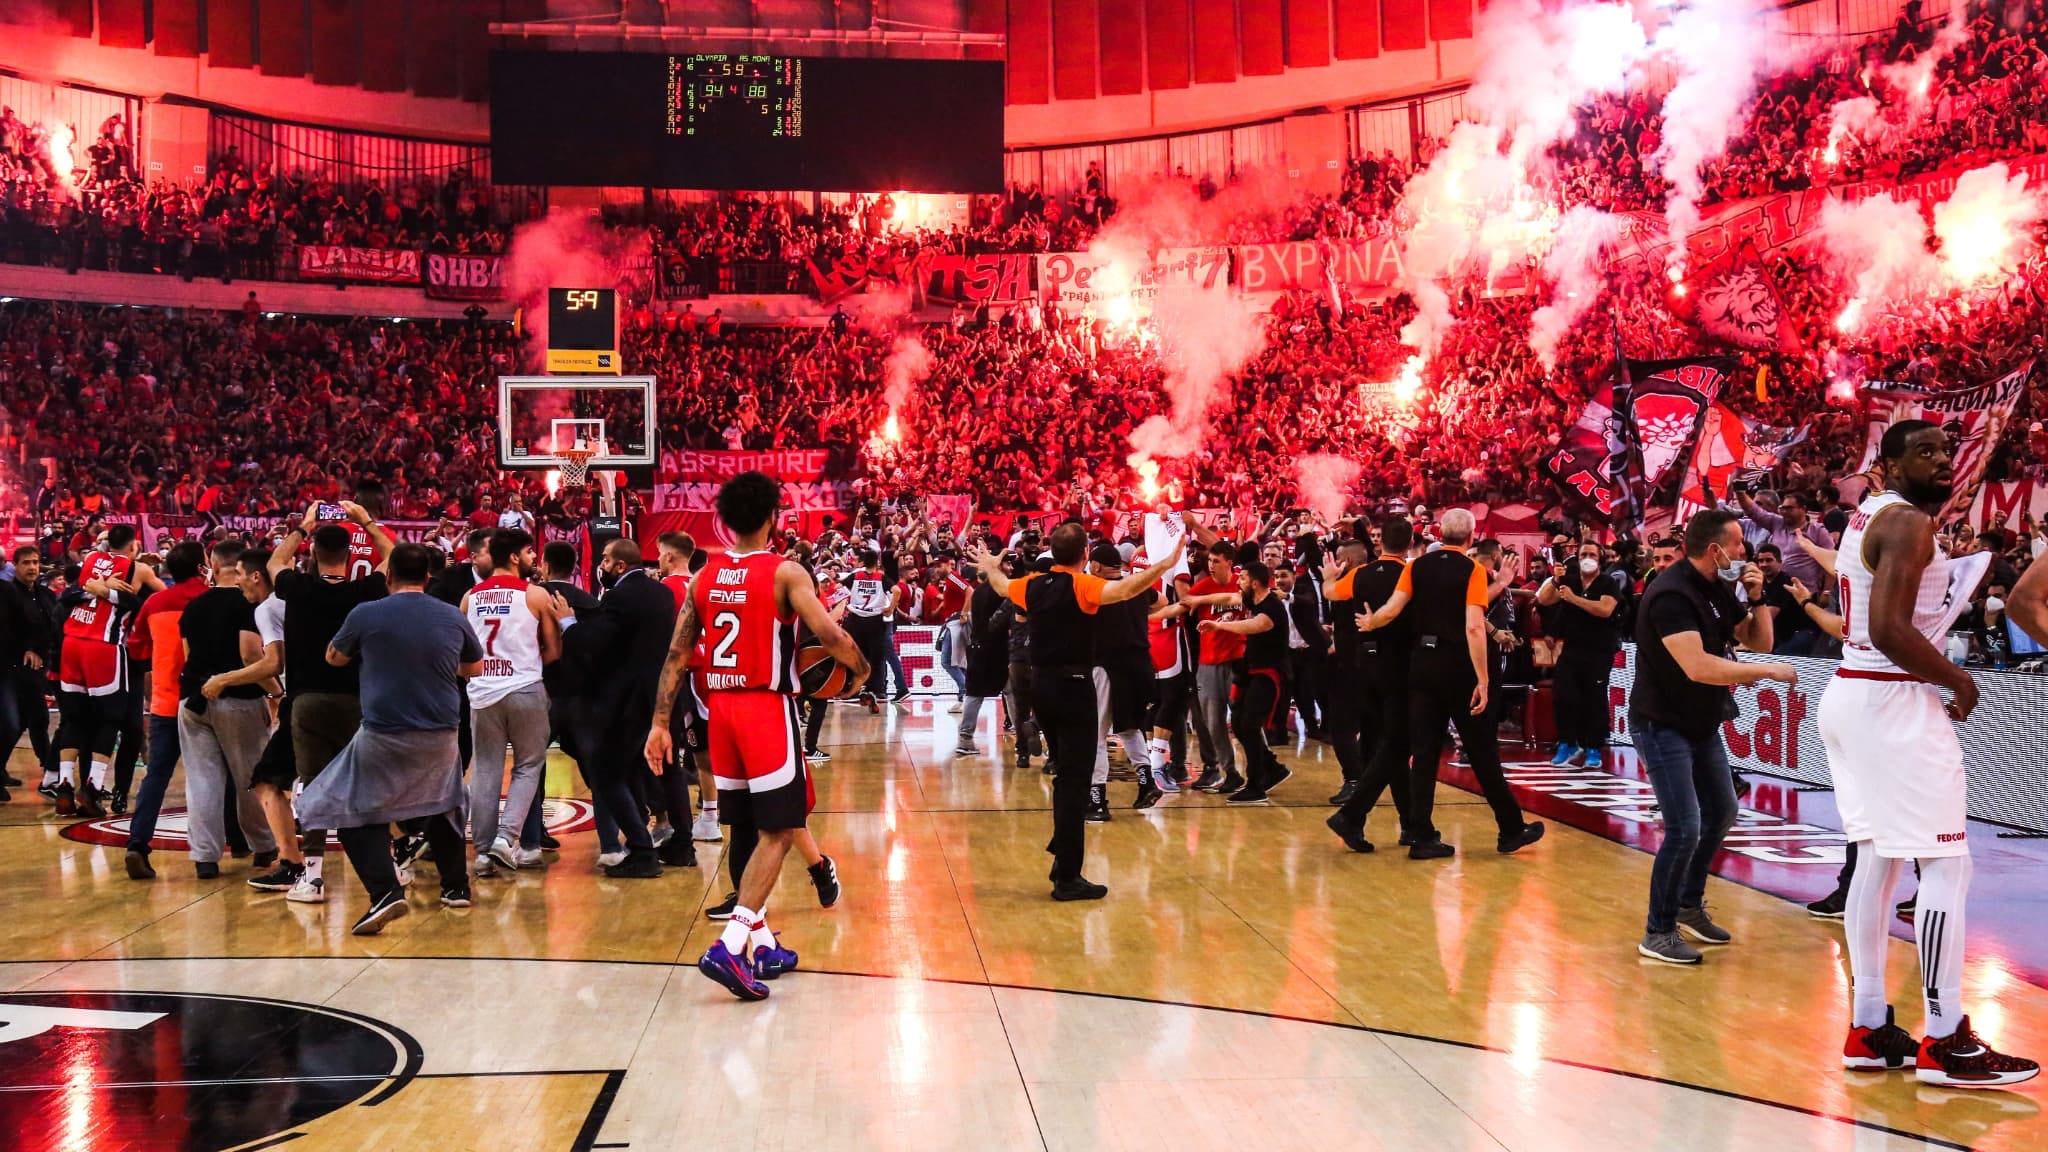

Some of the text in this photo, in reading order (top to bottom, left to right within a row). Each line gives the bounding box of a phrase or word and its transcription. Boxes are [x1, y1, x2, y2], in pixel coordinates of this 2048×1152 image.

[705, 84, 724, 97] 94
[352, 532, 367, 544] FALL
[716, 567, 748, 586] DORSEY
[475, 591, 514, 606] SPANOULIS
[484, 618, 501, 657] 7
[712, 611, 740, 669] 2
